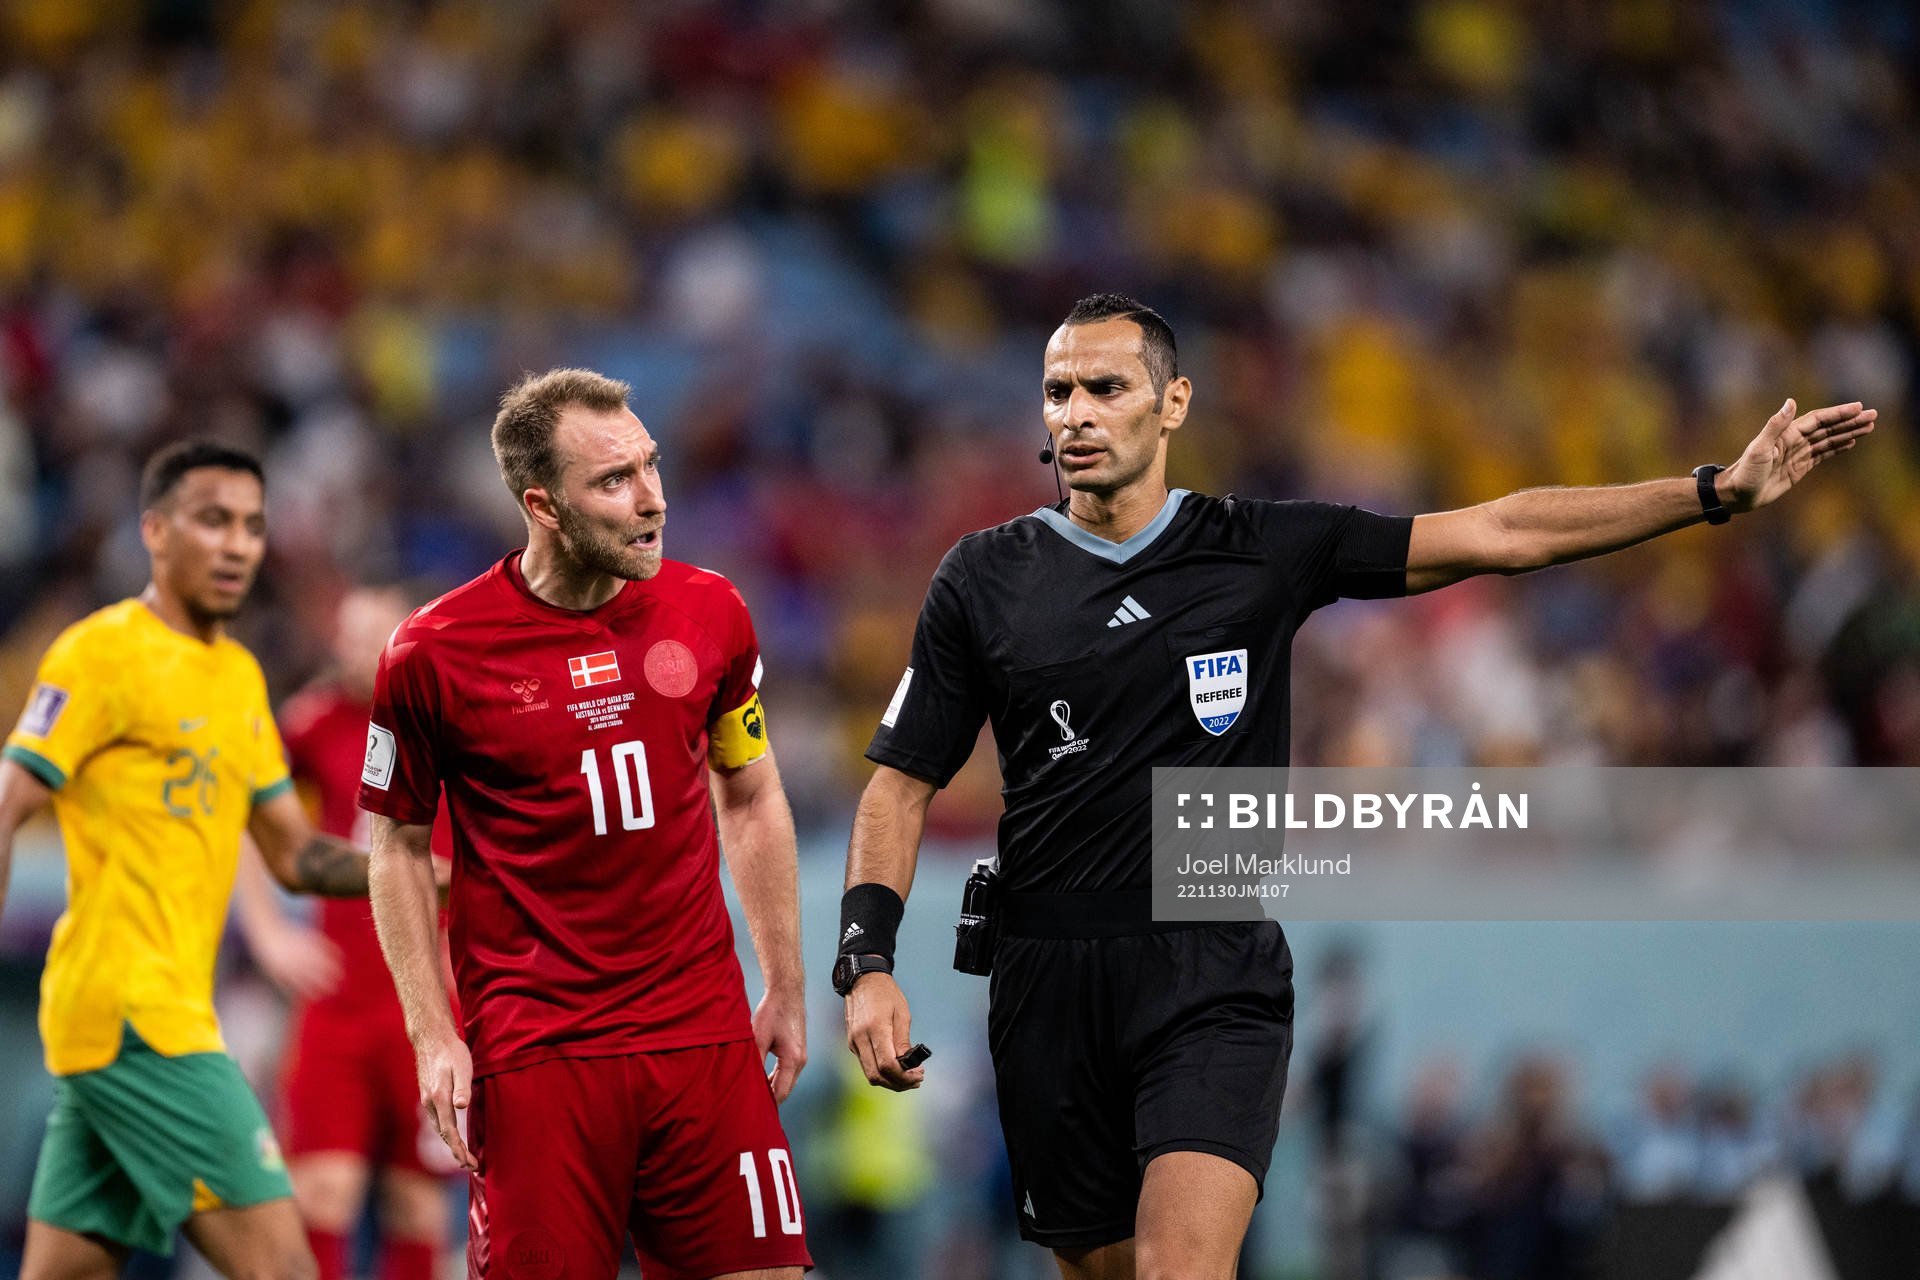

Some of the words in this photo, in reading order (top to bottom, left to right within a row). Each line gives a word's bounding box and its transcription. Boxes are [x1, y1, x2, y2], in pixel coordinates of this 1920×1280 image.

[1193, 655, 1242, 680] FIFA
[566, 703, 578, 712] FIFA
[578, 700, 596, 710] WORLD
[596, 697, 607, 707] CUP
[606, 695, 622, 705] QATAR
[622, 692, 635, 702] 2022
[1196, 687, 1242, 704] REFEREE
[511, 699, 549, 715] hummel
[575, 707, 601, 719] AUSTRALIA
[607, 702, 630, 713] DENMARK
[1209, 716, 1229, 728] 2022
[1048, 746, 1060, 754] FIFA
[1077, 738, 1090, 746] CUP
[1068, 744, 1087, 754] 2022
[163, 747, 219, 816] 26
[580, 740, 655, 836] 10
[739, 1149, 802, 1238] 10
